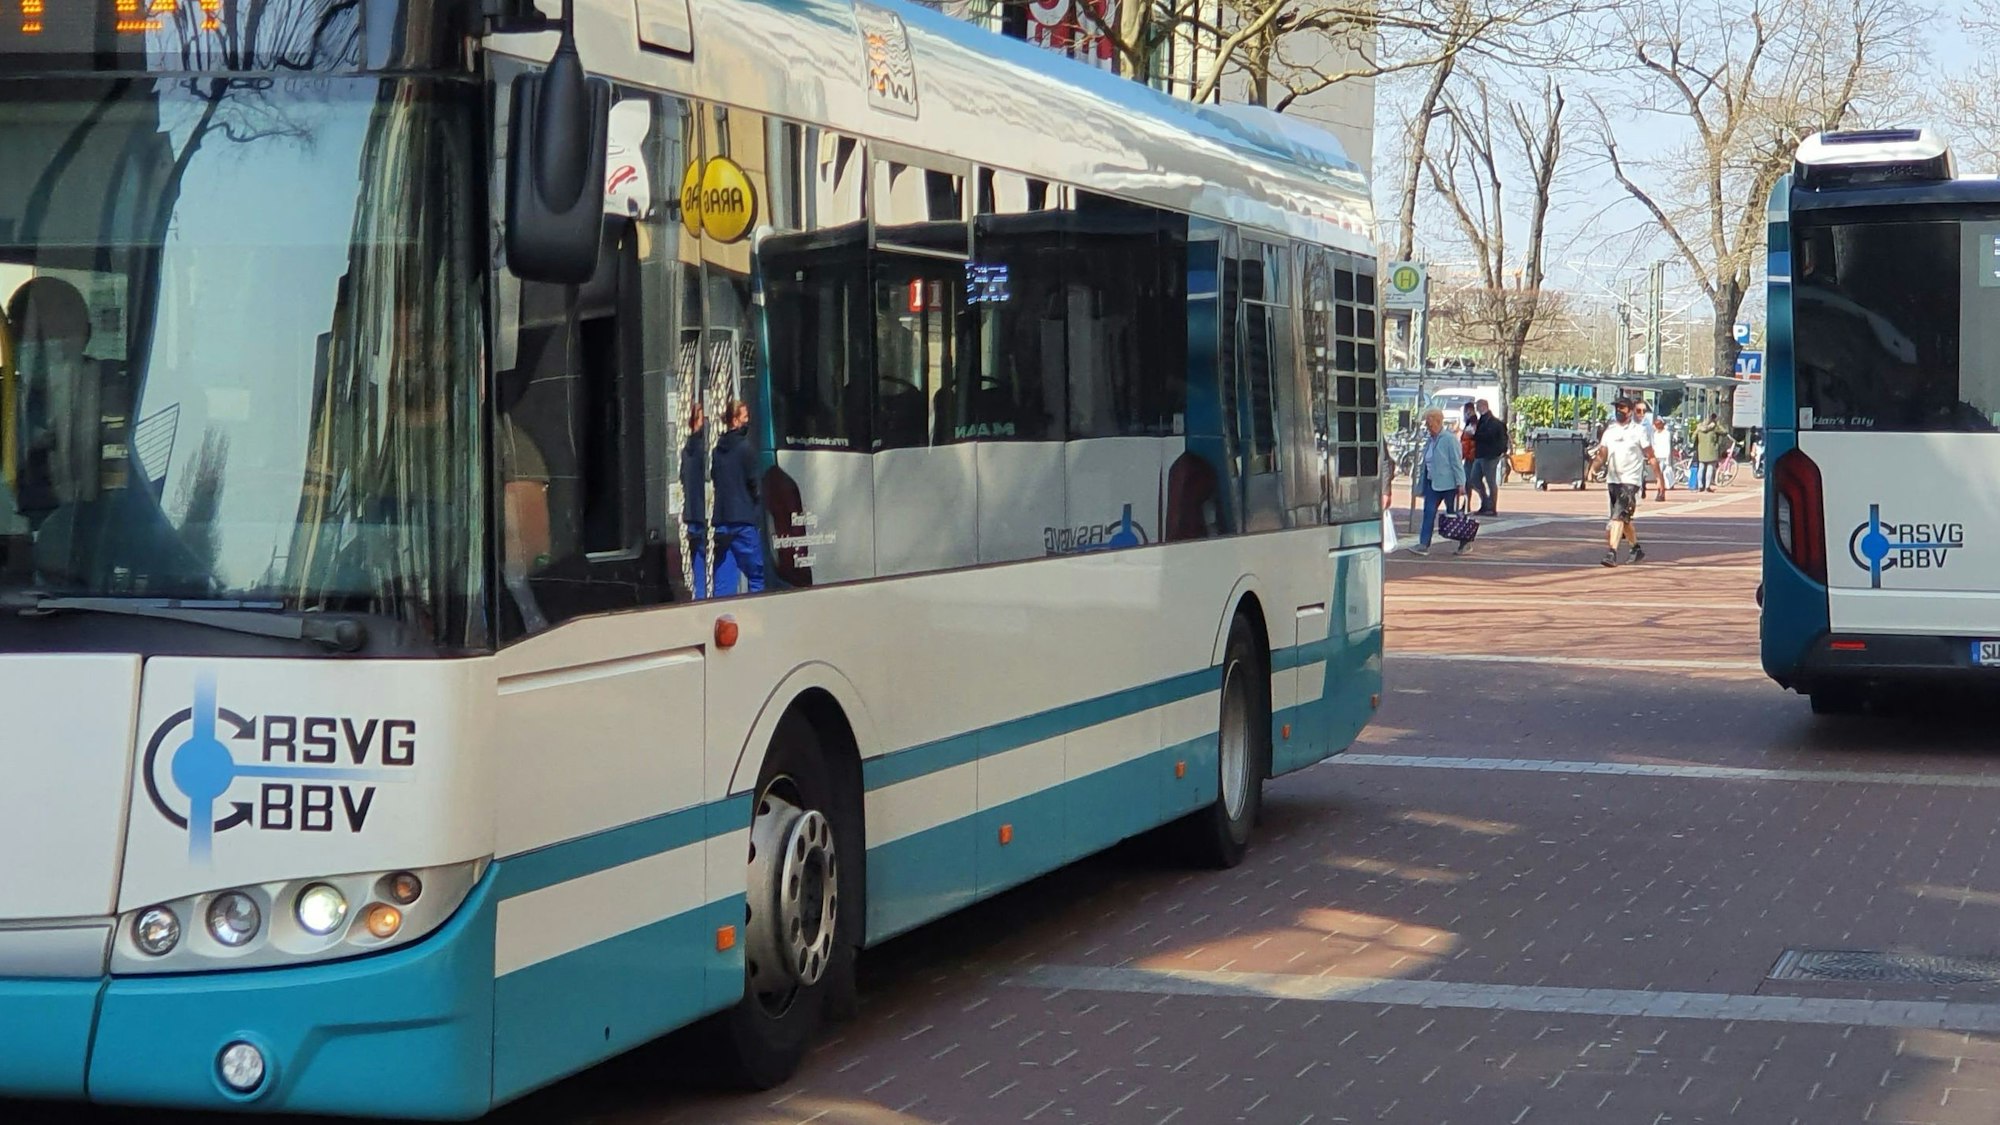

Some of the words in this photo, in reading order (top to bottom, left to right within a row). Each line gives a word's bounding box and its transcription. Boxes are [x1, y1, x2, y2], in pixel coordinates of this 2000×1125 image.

[1400, 271, 1412, 288] H
[1900, 523, 1964, 544] RSVG
[1900, 548, 1948, 568] BBV
[261, 715, 416, 766] RSVG
[260, 783, 377, 833] BBV
